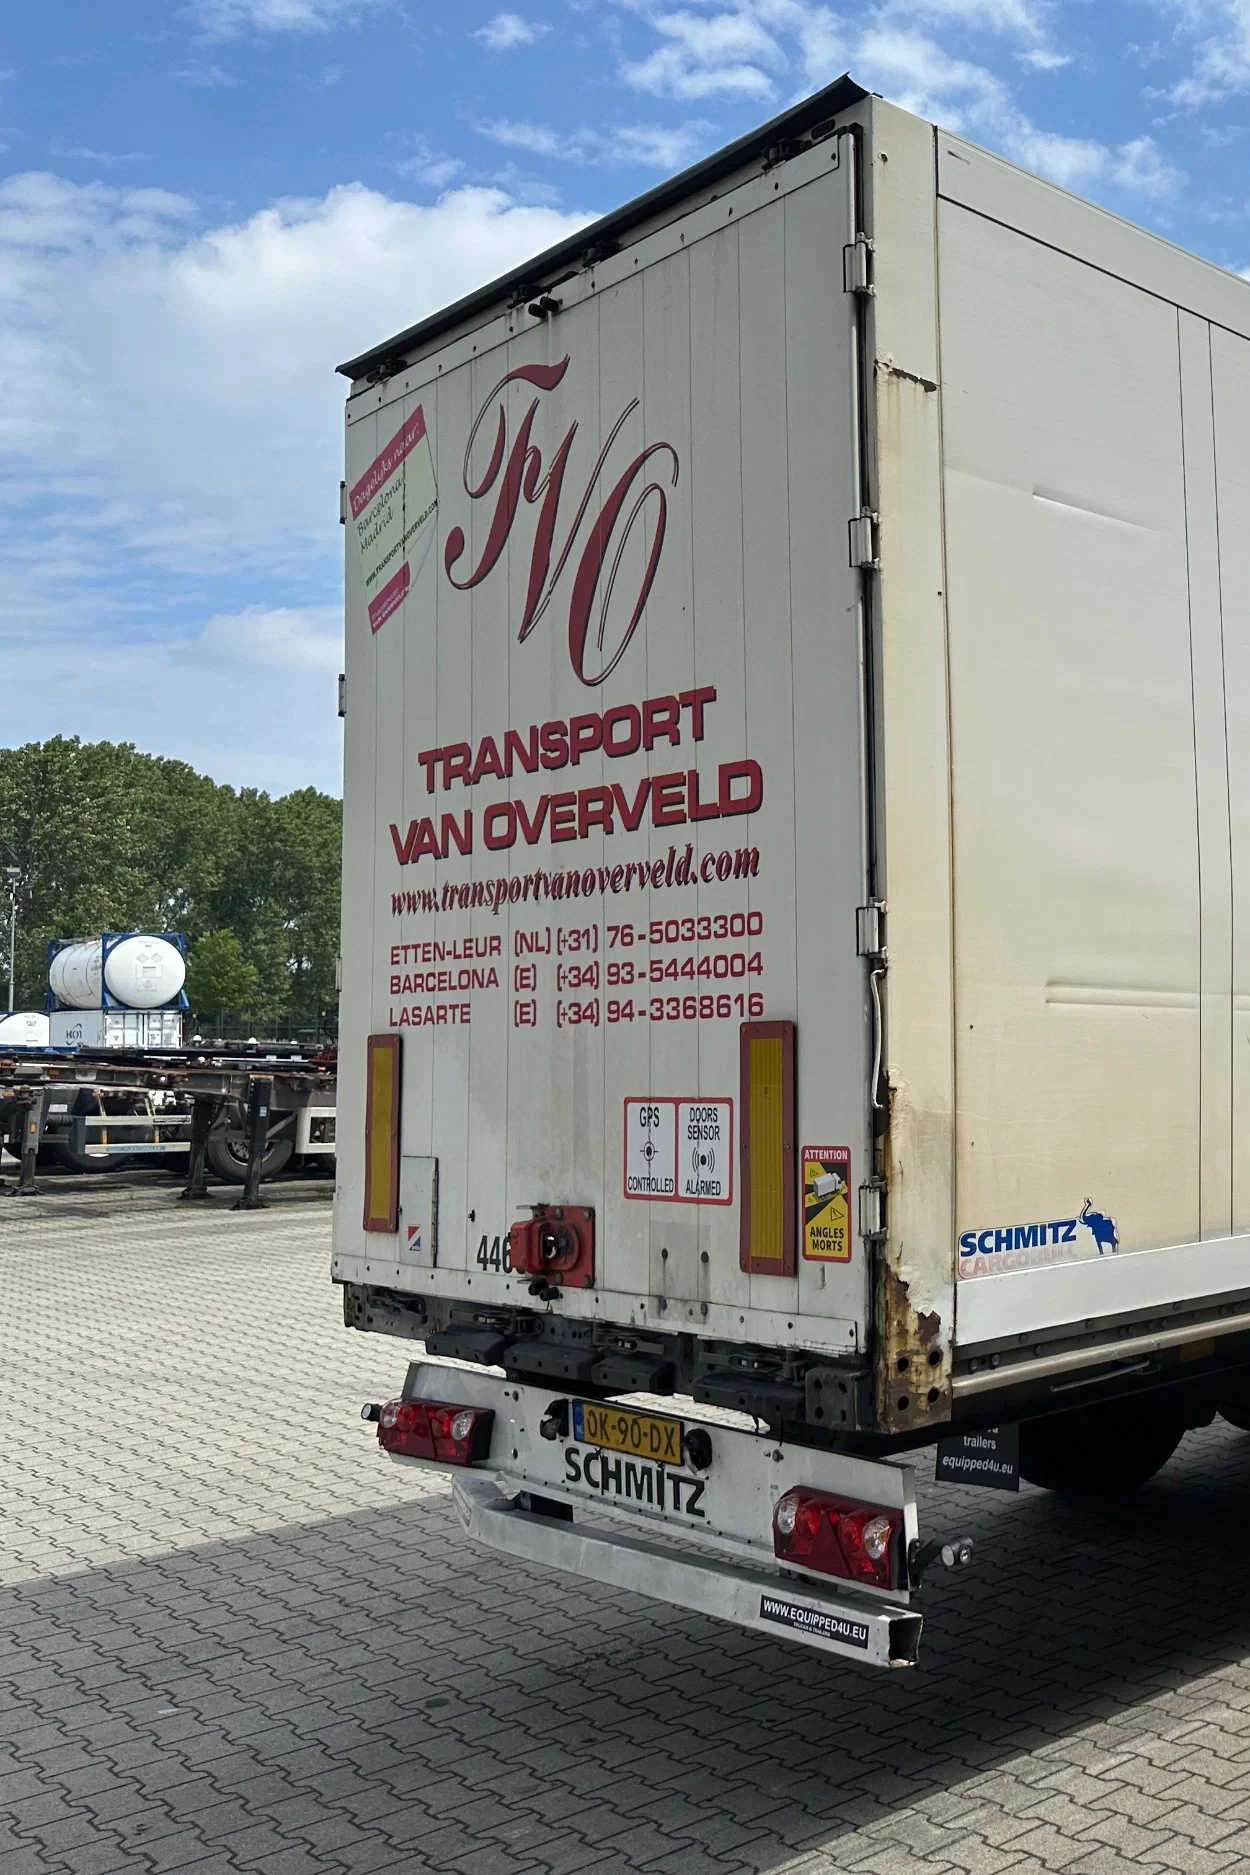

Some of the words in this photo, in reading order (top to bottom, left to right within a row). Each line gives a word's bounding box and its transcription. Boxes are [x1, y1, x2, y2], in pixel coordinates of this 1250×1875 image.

[393, 422, 419, 461] naar:
[357, 479, 402, 537] Barcelona
[360, 506, 394, 554] Madrid
[417, 686, 717, 794] TRANSPORT
[389, 809, 473, 866] VAN
[483, 759, 764, 851] OVERVELD
[391, 843, 760, 918] www.transportvanoverveld.com
[390, 935, 502, 966] ETTEN-LEUR
[514, 926, 551, 957] (NL)
[557, 928, 599, 955] (+31)
[389, 967, 500, 995] BARCELONA
[514, 965, 537, 992] (E)
[557, 961, 600, 990] (+34)
[388, 1003, 472, 1027] LASARTE
[514, 1001, 537, 1028] (E)
[557, 1001, 600, 1027] (+34)
[639, 1106, 660, 1128] GPS
[689, 1107, 718, 1123] DOORS
[687, 1125, 721, 1141] SENSOR
[804, 1149, 848, 1161] ATTENTION
[628, 1176, 674, 1193] CONTROLLED
[685, 1180, 721, 1197] ALARMED
[809, 1226, 845, 1240] ANGLES
[811, 1238, 843, 1252] MORTS
[960, 1219, 1077, 1257] SCHMITZ
[586, 1410, 676, 1458] OK-90-DX
[963, 1435, 997, 1450] trailers
[942, 1455, 1014, 1474] equipped4u.eu
[565, 1447, 706, 1518] SCHMITZ
[763, 1599, 867, 1640] WWW.EQUIPPED4U.EU
